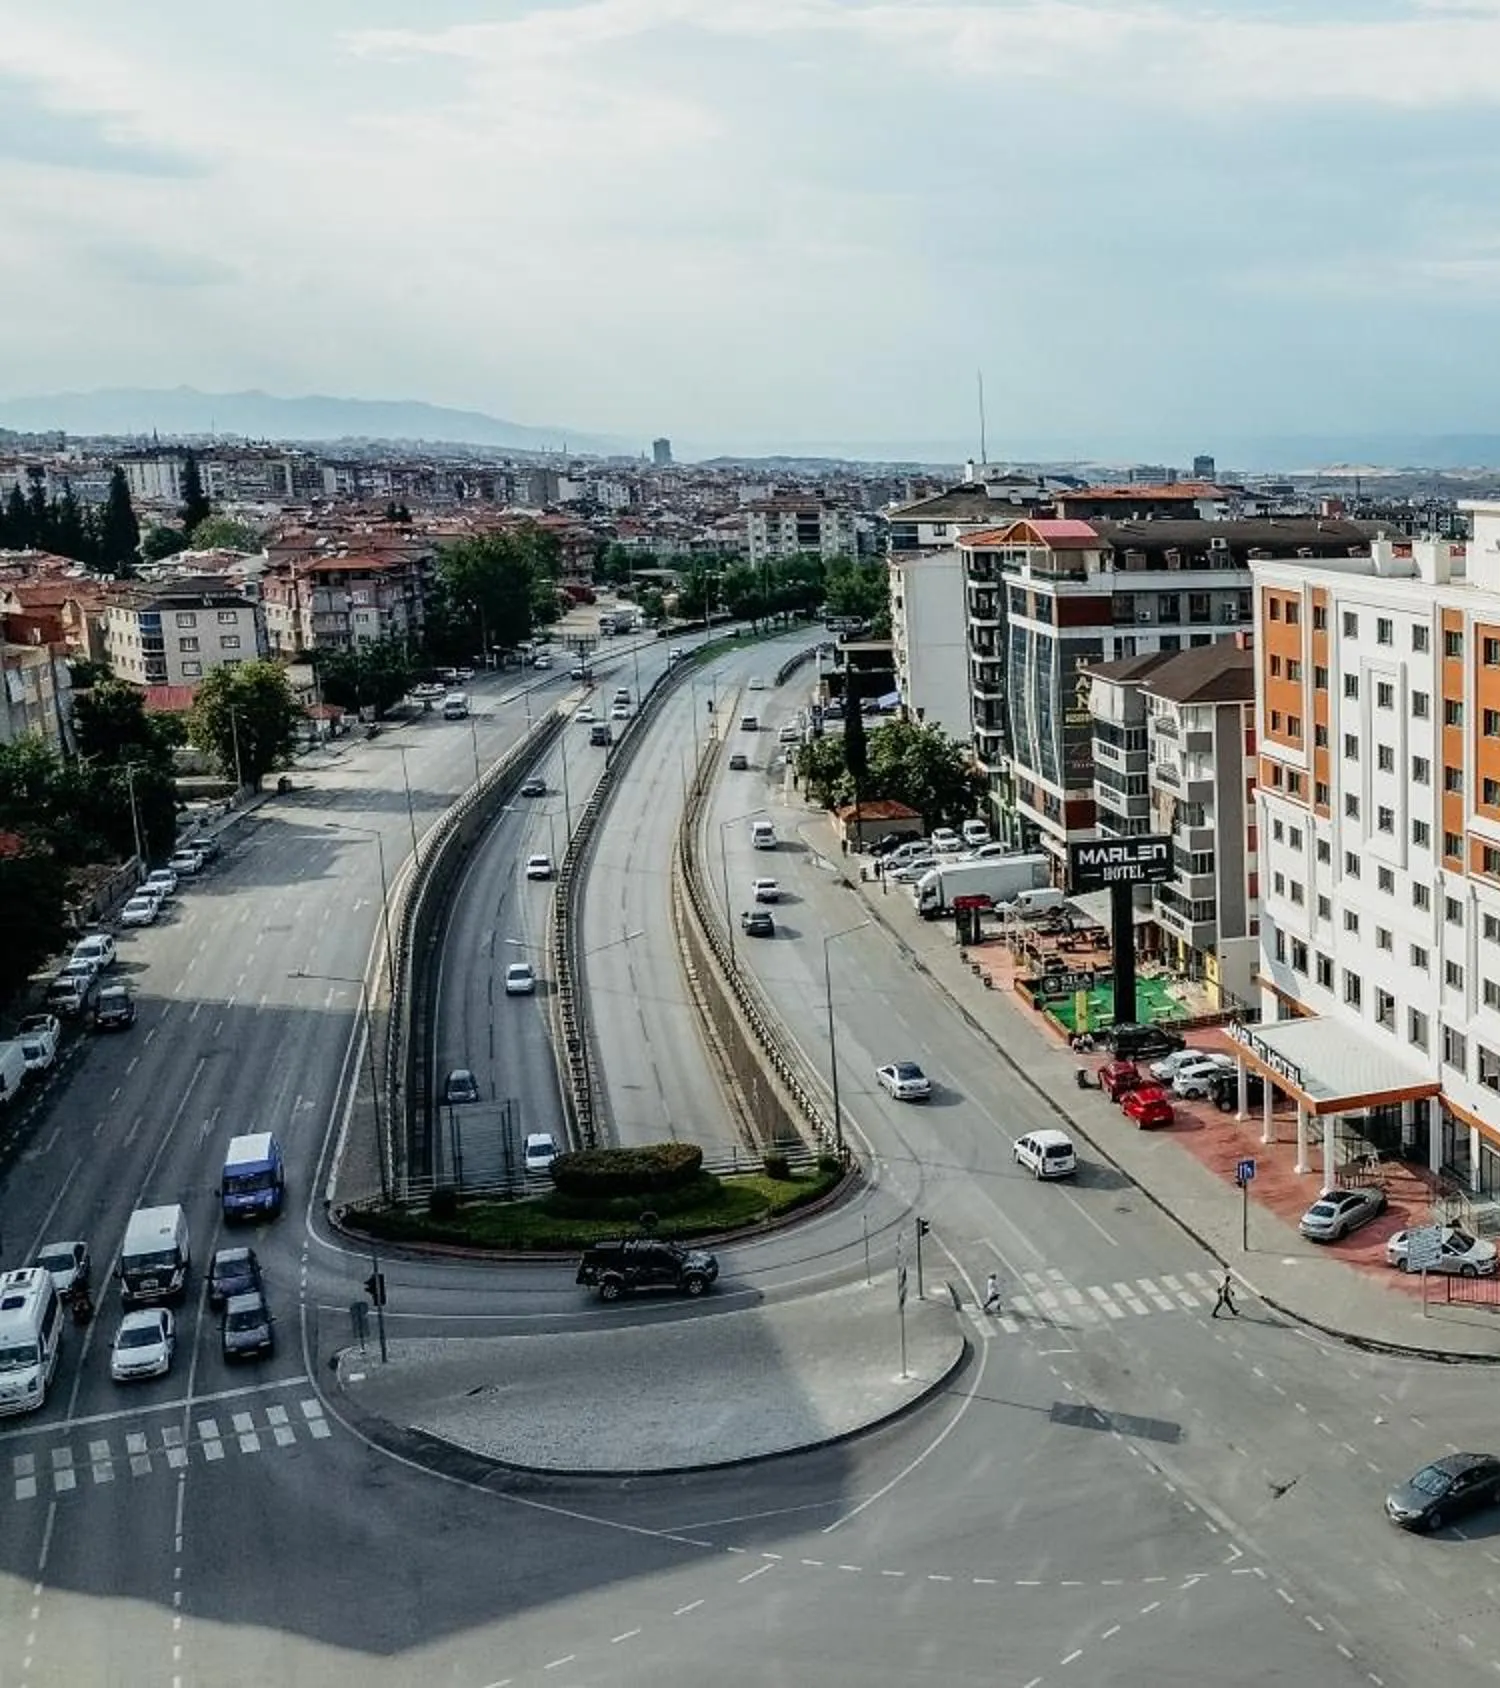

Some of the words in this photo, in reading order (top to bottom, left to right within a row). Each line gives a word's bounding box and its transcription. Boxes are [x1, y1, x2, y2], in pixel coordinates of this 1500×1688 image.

[1078, 844, 1167, 865] MARLEN
[1103, 865, 1145, 881] HOTEL
[1267, 1048, 1299, 1089] HOTEL
